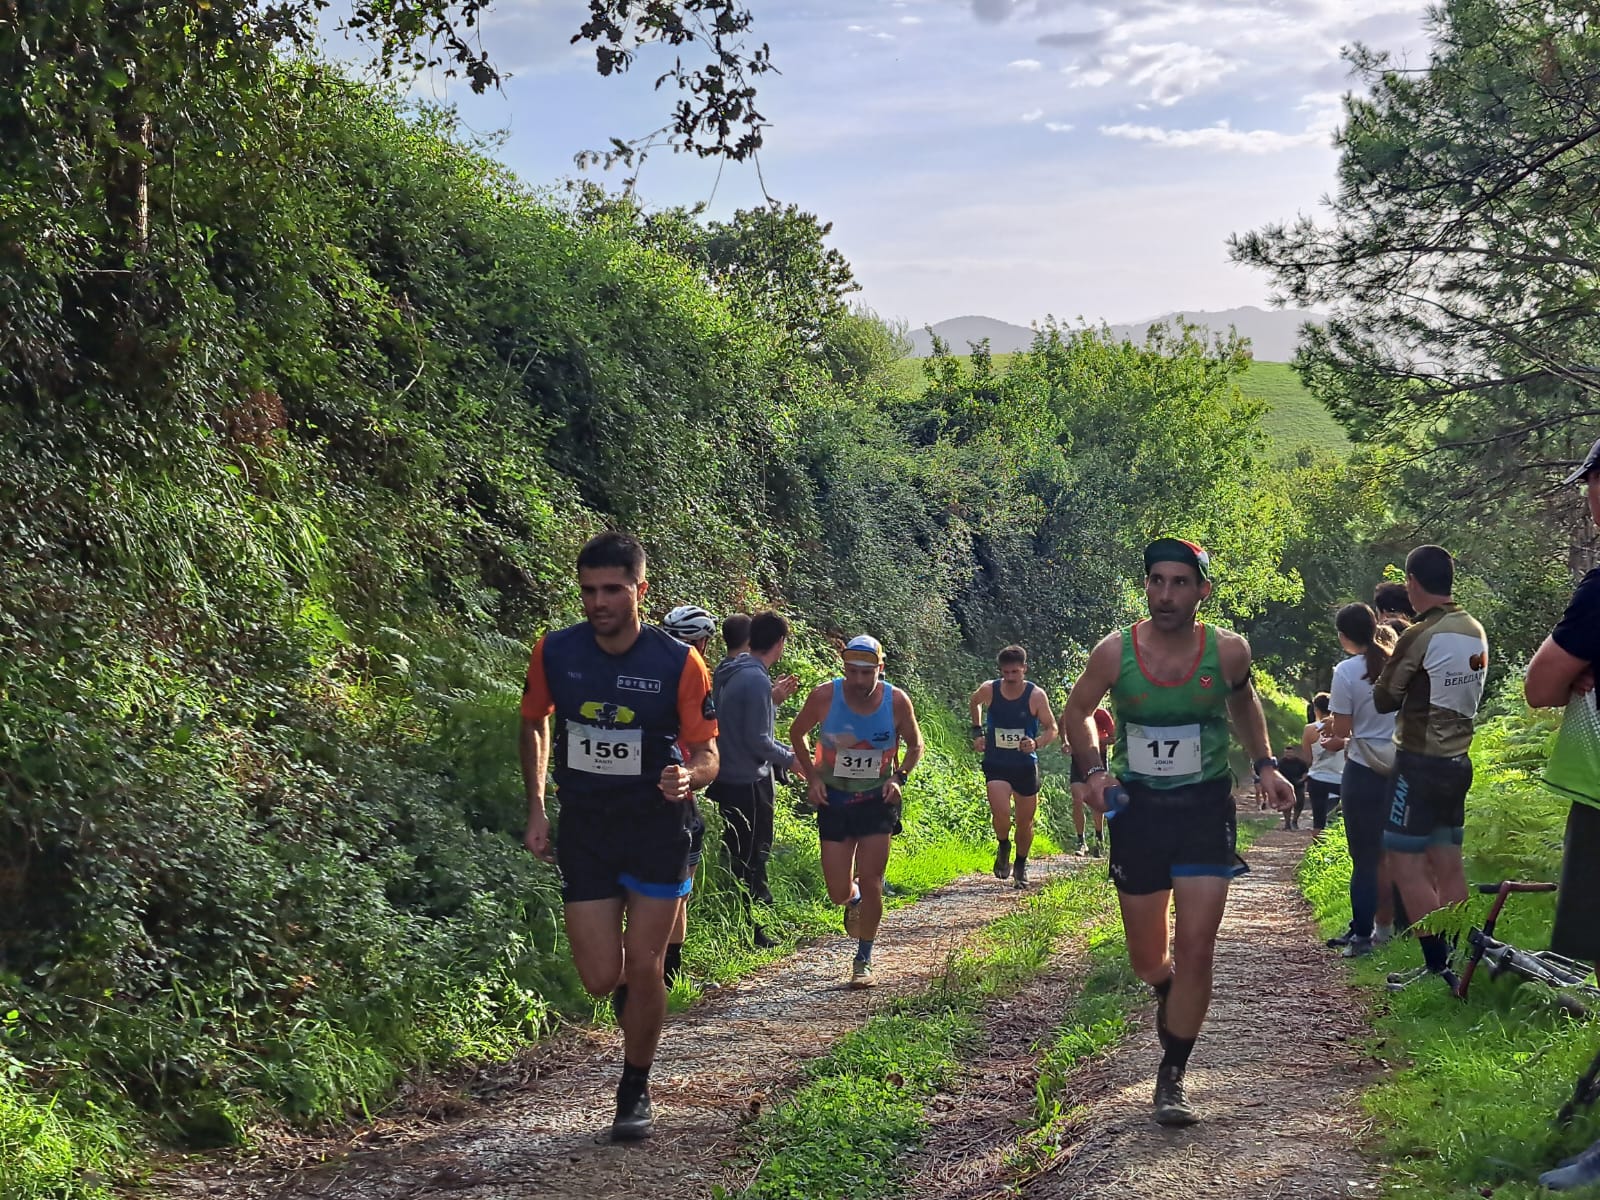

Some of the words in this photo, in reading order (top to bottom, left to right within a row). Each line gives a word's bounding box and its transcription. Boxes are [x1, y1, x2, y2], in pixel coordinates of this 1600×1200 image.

[1000, 733, 1019, 741] 153
[580, 738, 629, 759] 156
[1147, 740, 1180, 758] 17
[842, 756, 872, 768] 311
